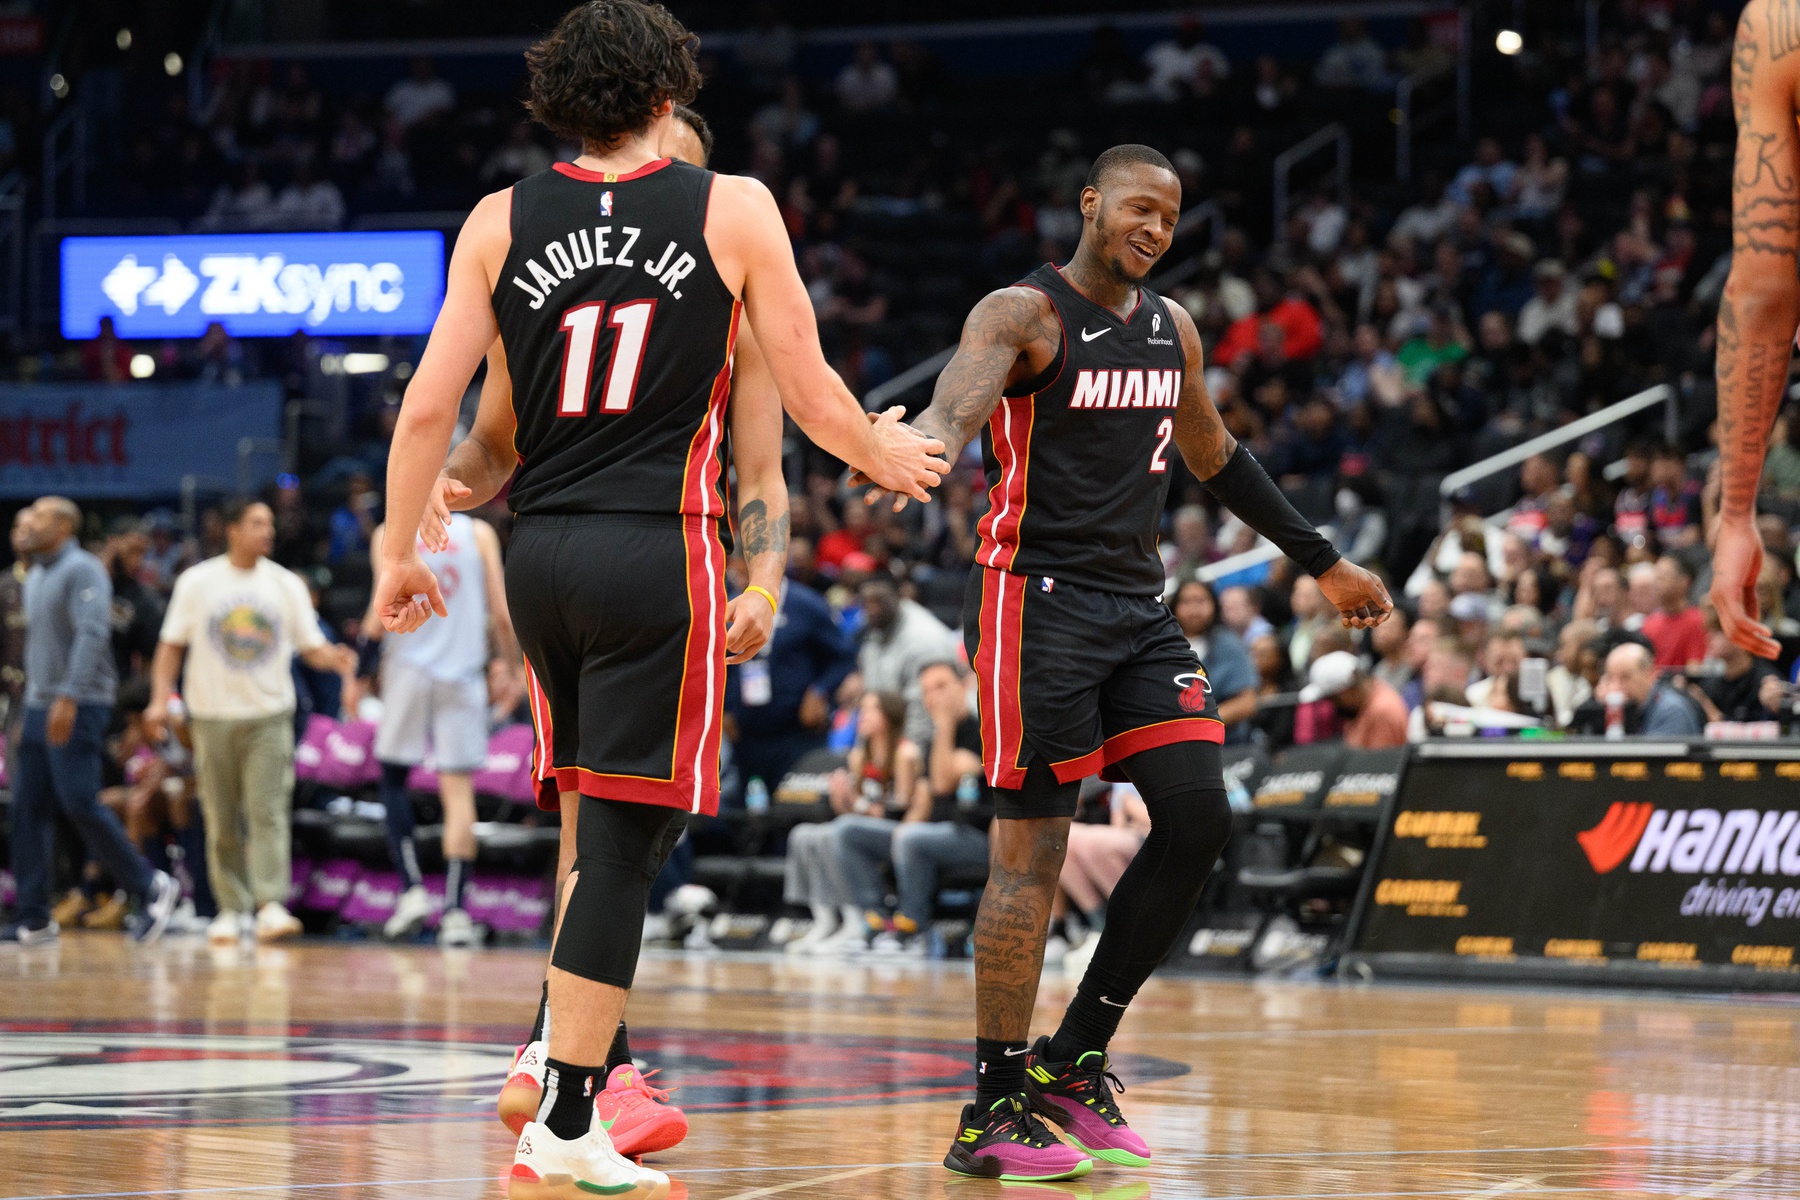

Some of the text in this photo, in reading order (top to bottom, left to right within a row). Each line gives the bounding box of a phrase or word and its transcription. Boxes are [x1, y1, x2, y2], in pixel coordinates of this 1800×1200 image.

[200, 253, 404, 326] ZKsync
[512, 226, 696, 310] JAQUEZ JR.
[556, 298, 658, 417] 11
[1147, 337, 1173, 346] Robinhood
[1068, 368, 1182, 409] MIAMI
[1149, 416, 1174, 473] 2
[1679, 876, 1774, 927] driving
